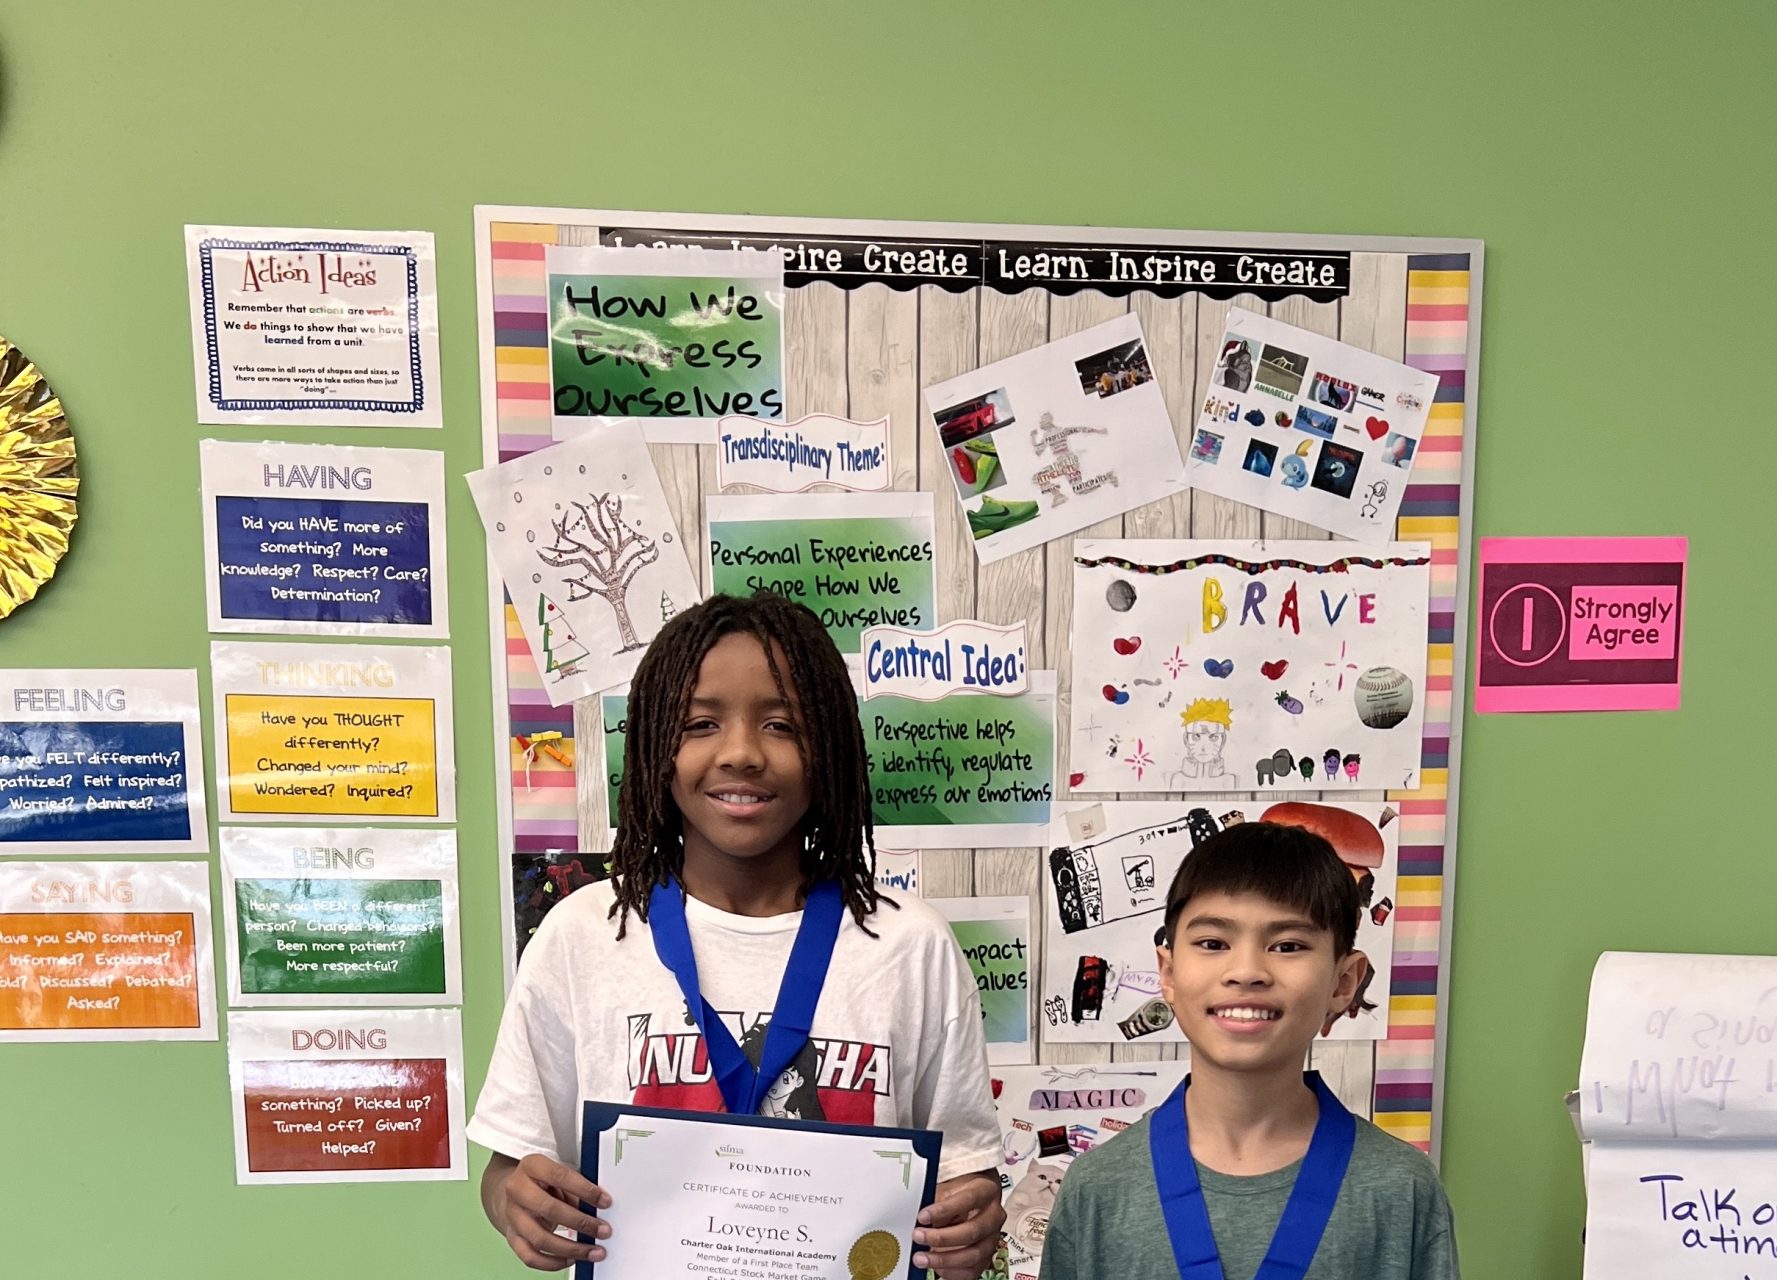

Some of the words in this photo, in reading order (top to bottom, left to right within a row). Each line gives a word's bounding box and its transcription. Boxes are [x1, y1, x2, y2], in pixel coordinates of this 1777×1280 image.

[864, 244, 967, 276] Create
[999, 249, 1089, 280] Learn
[1110, 252, 1216, 284] Inspire
[1236, 255, 1335, 286] Create
[242, 251, 311, 292] Action
[319, 253, 376, 294] Ideas
[228, 303, 283, 313] Remember
[286, 304, 306, 314] that
[309, 306, 344, 314] actions
[565, 285, 666, 318] How
[689, 286, 763, 320] We
[224, 322, 240, 330] We
[244, 322, 256, 331] do
[260, 322, 290, 332] things
[294, 324, 304, 332] to
[307, 324, 333, 333] show
[337, 325, 357, 333] that
[379, 326, 403, 334] have
[572, 330, 761, 377] Express
[1315, 372, 1357, 392] ROBLOX
[1254, 383, 1295, 402] ANNABELLE
[722, 427, 831, 479] Transdisciplinary
[837, 442, 884, 471] Theme:
[264, 464, 372, 490] HAVING
[242, 516, 263, 530] Did
[268, 519, 293, 533] you
[299, 517, 338, 532] HAVE
[344, 521, 380, 533] more
[385, 522, 403, 533] of
[260, 542, 341, 558] something?
[353, 544, 388, 556] More
[711, 540, 800, 566] Personal
[810, 539, 932, 570] Experiences
[221, 563, 301, 579] knowledge?
[313, 564, 378, 581] Respect?
[384, 567, 428, 581] Care?
[271, 586, 380, 602] Determination?
[747, 575, 806, 597] Shape
[816, 575, 859, 595] How
[868, 572, 901, 594] We
[1202, 576, 1375, 634] BRAVE
[1574, 597, 1673, 623] Strongly
[1586, 624, 1659, 649] Agree
[868, 639, 951, 683] Central
[962, 644, 1024, 686] Idea:
[257, 662, 394, 688] THINKING
[14, 689, 125, 711] FEELING
[261, 712, 296, 725] Have
[302, 715, 327, 728] you
[333, 713, 404, 727] THOUGHT
[875, 716, 969, 747] Perspective
[976, 719, 1015, 746] helps
[285, 737, 379, 753] differently?
[15, 756, 41, 769] you
[46, 752, 85, 764] FELT
[88, 751, 180, 767] differently?
[257, 758, 320, 775] Changed
[327, 763, 359, 776] your
[367, 761, 408, 775] mind?
[883, 747, 954, 781] identify,
[962, 749, 1032, 786] regulate
[84, 775, 113, 787] Felt
[119, 774, 182, 790] inspired?
[255, 783, 335, 797] Wondered?
[347, 785, 413, 802] Inquired?
[875, 784, 937, 811] express
[944, 786, 970, 803] our
[978, 781, 1051, 803] emotions
[9, 796, 74, 810] Worried?
[86, 796, 153, 810] Admired?
[293, 847, 374, 869] BEING
[32, 880, 133, 904] SAYING
[245, 920, 297, 935] person?
[307, 920, 362, 934] Changed
[367, 921, 435, 934] behaviors?
[34, 935, 59, 947] you
[65, 930, 96, 944] SAID
[102, 931, 182, 946] something?
[277, 940, 307, 952] Been
[312, 941, 344, 951] more
[350, 940, 405, 955] patient?
[9, 953, 84, 966] Informed?
[96, 953, 170, 966] Explained?
[286, 960, 318, 971] More
[323, 959, 398, 974] respectful?
[40, 975, 114, 988] Discussed?
[125, 975, 192, 988] Debated?
[974, 971, 1027, 990] alues
[67, 996, 119, 1010] Asked?
[292, 1029, 387, 1050] DOING
[261, 1097, 343, 1113] something?
[354, 1097, 400, 1110] Picked
[406, 1096, 431, 1111] up?
[1040, 1089, 1136, 1109] MAGIC
[273, 1119, 321, 1133] Turned
[327, 1119, 364, 1132] off?
[376, 1118, 422, 1132] Given?
[1012, 1118, 1032, 1132] Tech
[322, 1141, 376, 1157] Helped?
[730, 1162, 811, 1177] FOUNDATION
[683, 1182, 748, 1197] CERTIFICATE
[752, 1190, 766, 1198] OF
[769, 1192, 843, 1204] ACHIEVEMENT
[1640, 1174, 1740, 1226] Talk
[735, 1203, 775, 1212] AWARDED
[707, 1216, 789, 1243] Loveyne
[796, 1225, 812, 1242] S.
[681, 1238, 713, 1249] Charter
[716, 1243, 732, 1251] Oak
[736, 1246, 794, 1257] International
[797, 1251, 837, 1261] Academy
[1008, 1236, 1025, 1254] Think
[697, 1253, 729, 1262] Member
[772, 1261, 792, 1269] Place
[795, 1263, 818, 1271] Team
[1009, 1255, 1034, 1265] Smart
[687, 1263, 737, 1275] Connecticut
[741, 1270, 764, 1279] Stock
[768, 1272, 798, 1280] Market
